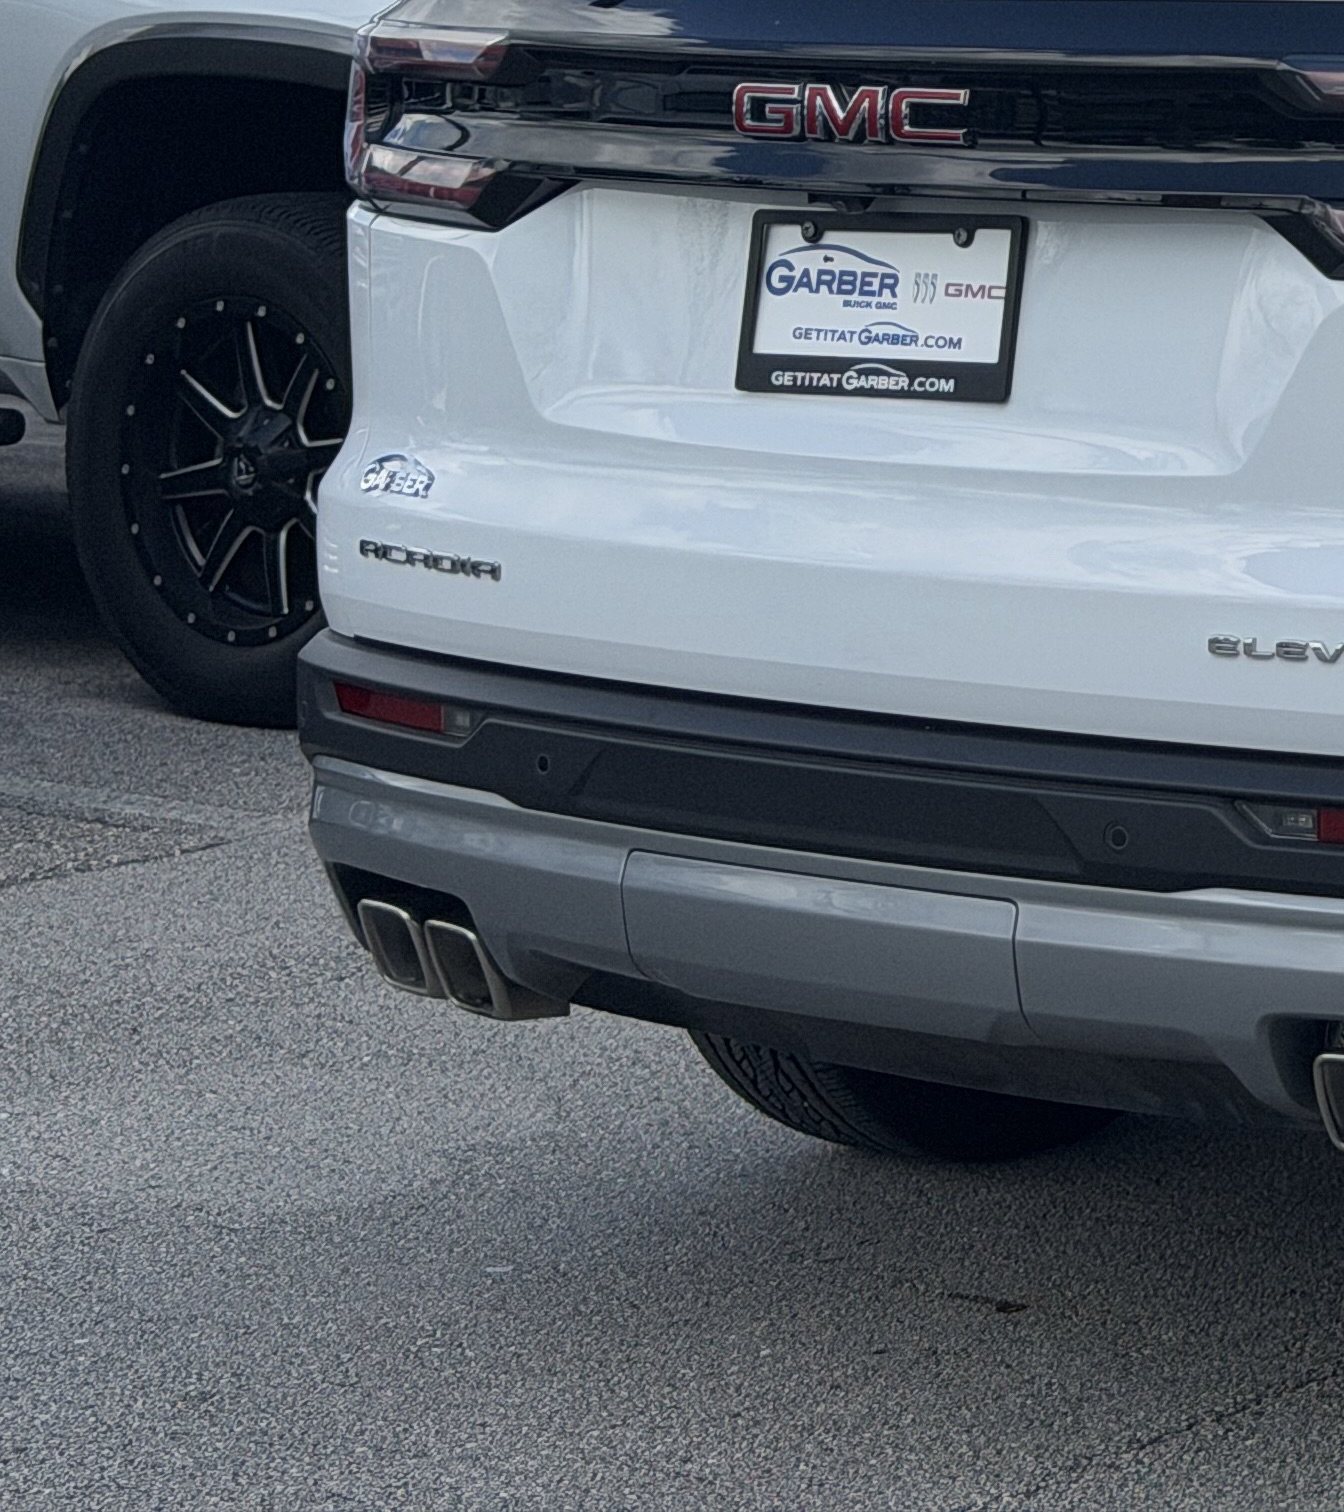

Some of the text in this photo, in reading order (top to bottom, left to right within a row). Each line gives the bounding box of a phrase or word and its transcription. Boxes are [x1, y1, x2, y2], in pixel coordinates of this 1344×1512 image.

[733, 82, 970, 146] GMC
[765, 258, 1006, 300] GARBER GMC
[842, 299, 898, 310] BUICK GMC
[359, 538, 502, 582] ACADIA
